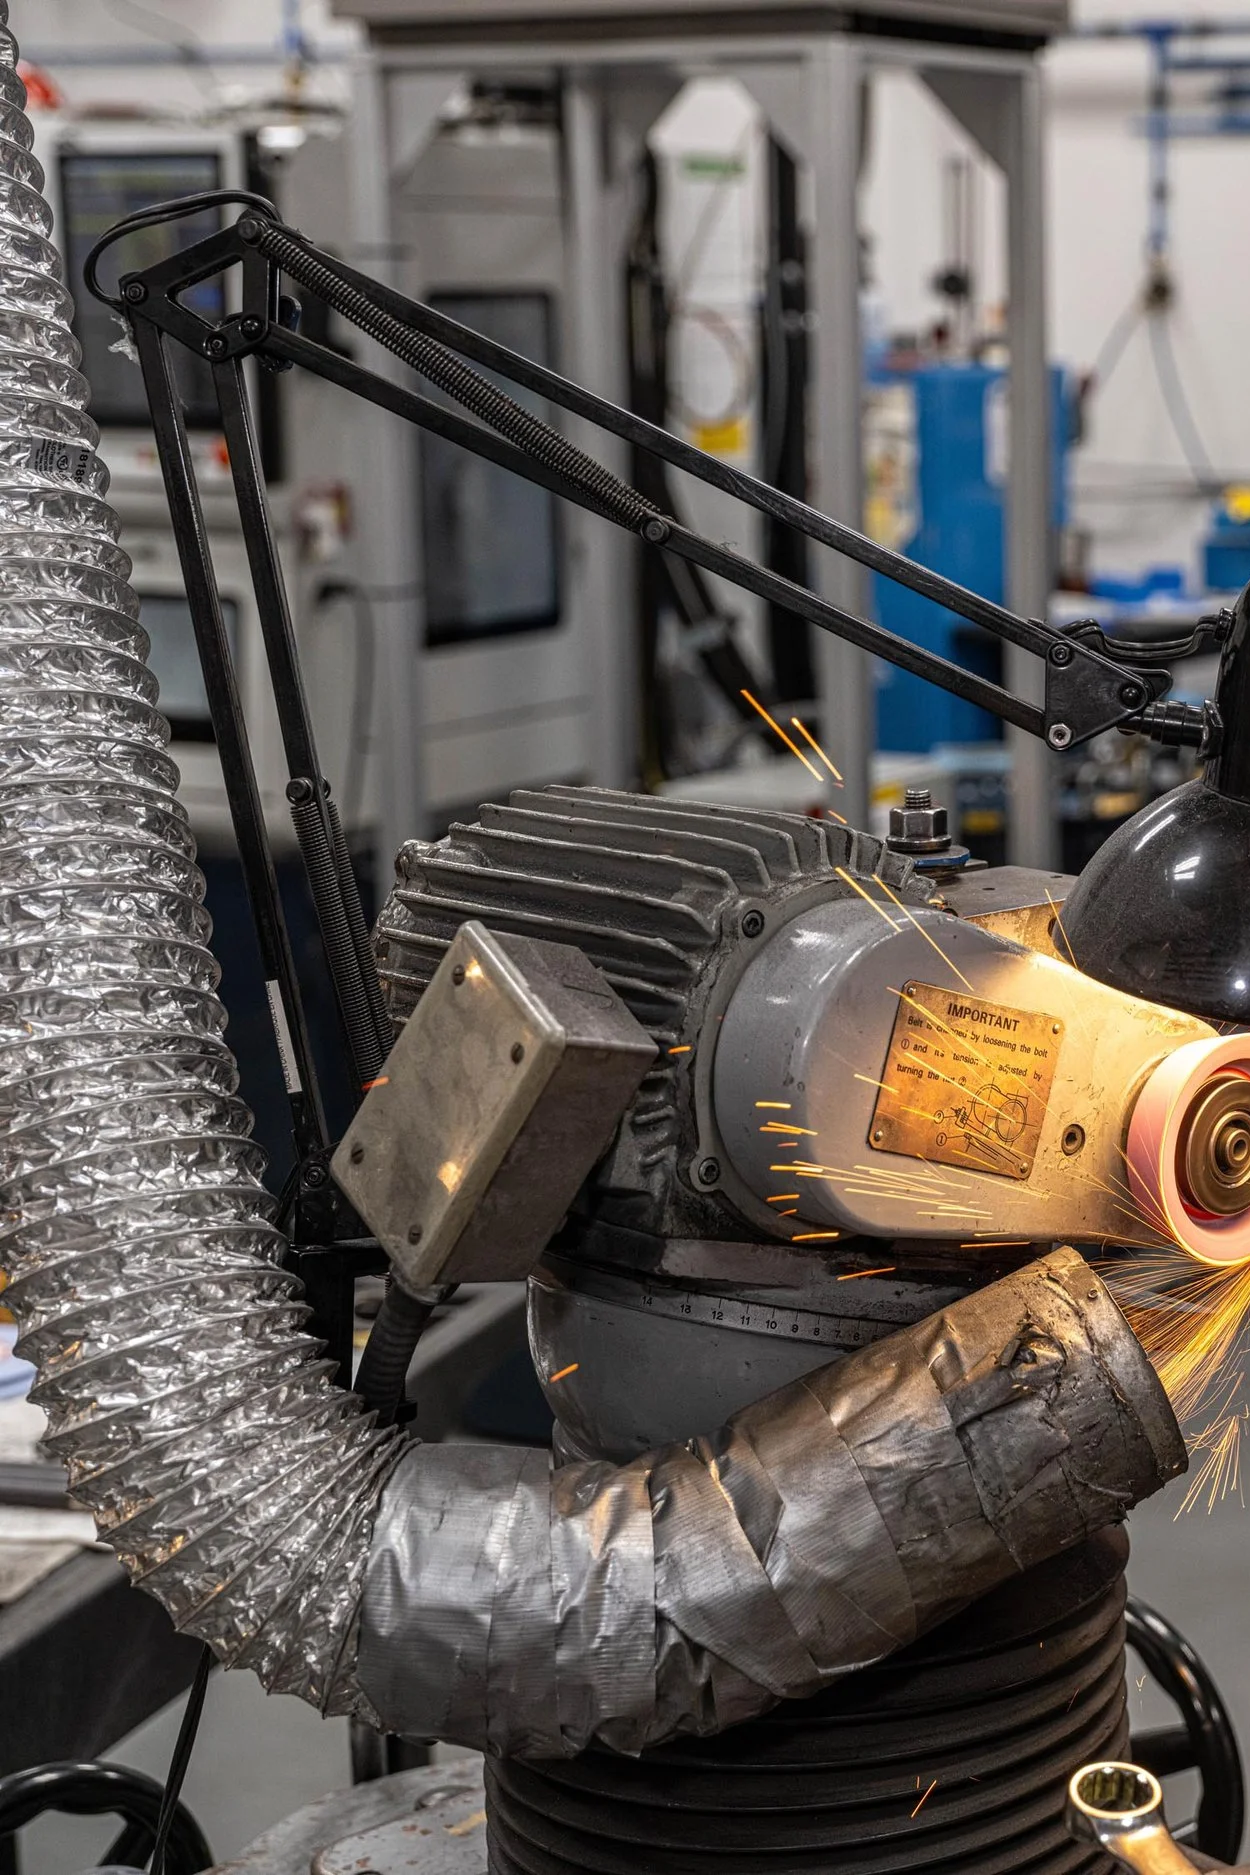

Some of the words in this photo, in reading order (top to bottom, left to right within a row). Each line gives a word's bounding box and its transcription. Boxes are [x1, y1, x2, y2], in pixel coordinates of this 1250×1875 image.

[947, 1002, 1020, 1031] IMPORTANT
[908, 1015, 923, 1028] Belt
[970, 1031, 980, 1043] by
[983, 1034, 1016, 1052] loosening
[1020, 1043, 1031, 1054] the
[1034, 1046, 1048, 1058] bolt
[896, 1063, 924, 1078] turning
[927, 1071, 940, 1081] the
[913, 1044, 928, 1054] and
[952, 1053, 979, 1066] tension
[1033, 1070, 1043, 1082] by
[642, 1295, 653, 1307] 14
[680, 1303, 692, 1314] 13
[711, 1310, 724, 1321] 12
[740, 1315, 751, 1326] 11
[765, 1319, 777, 1330] 10
[791, 1323, 799, 1334] 9
[813, 1327, 821, 1337] 8
[834, 1330, 841, 1339] 7
[853, 1332, 861, 1342] 6
